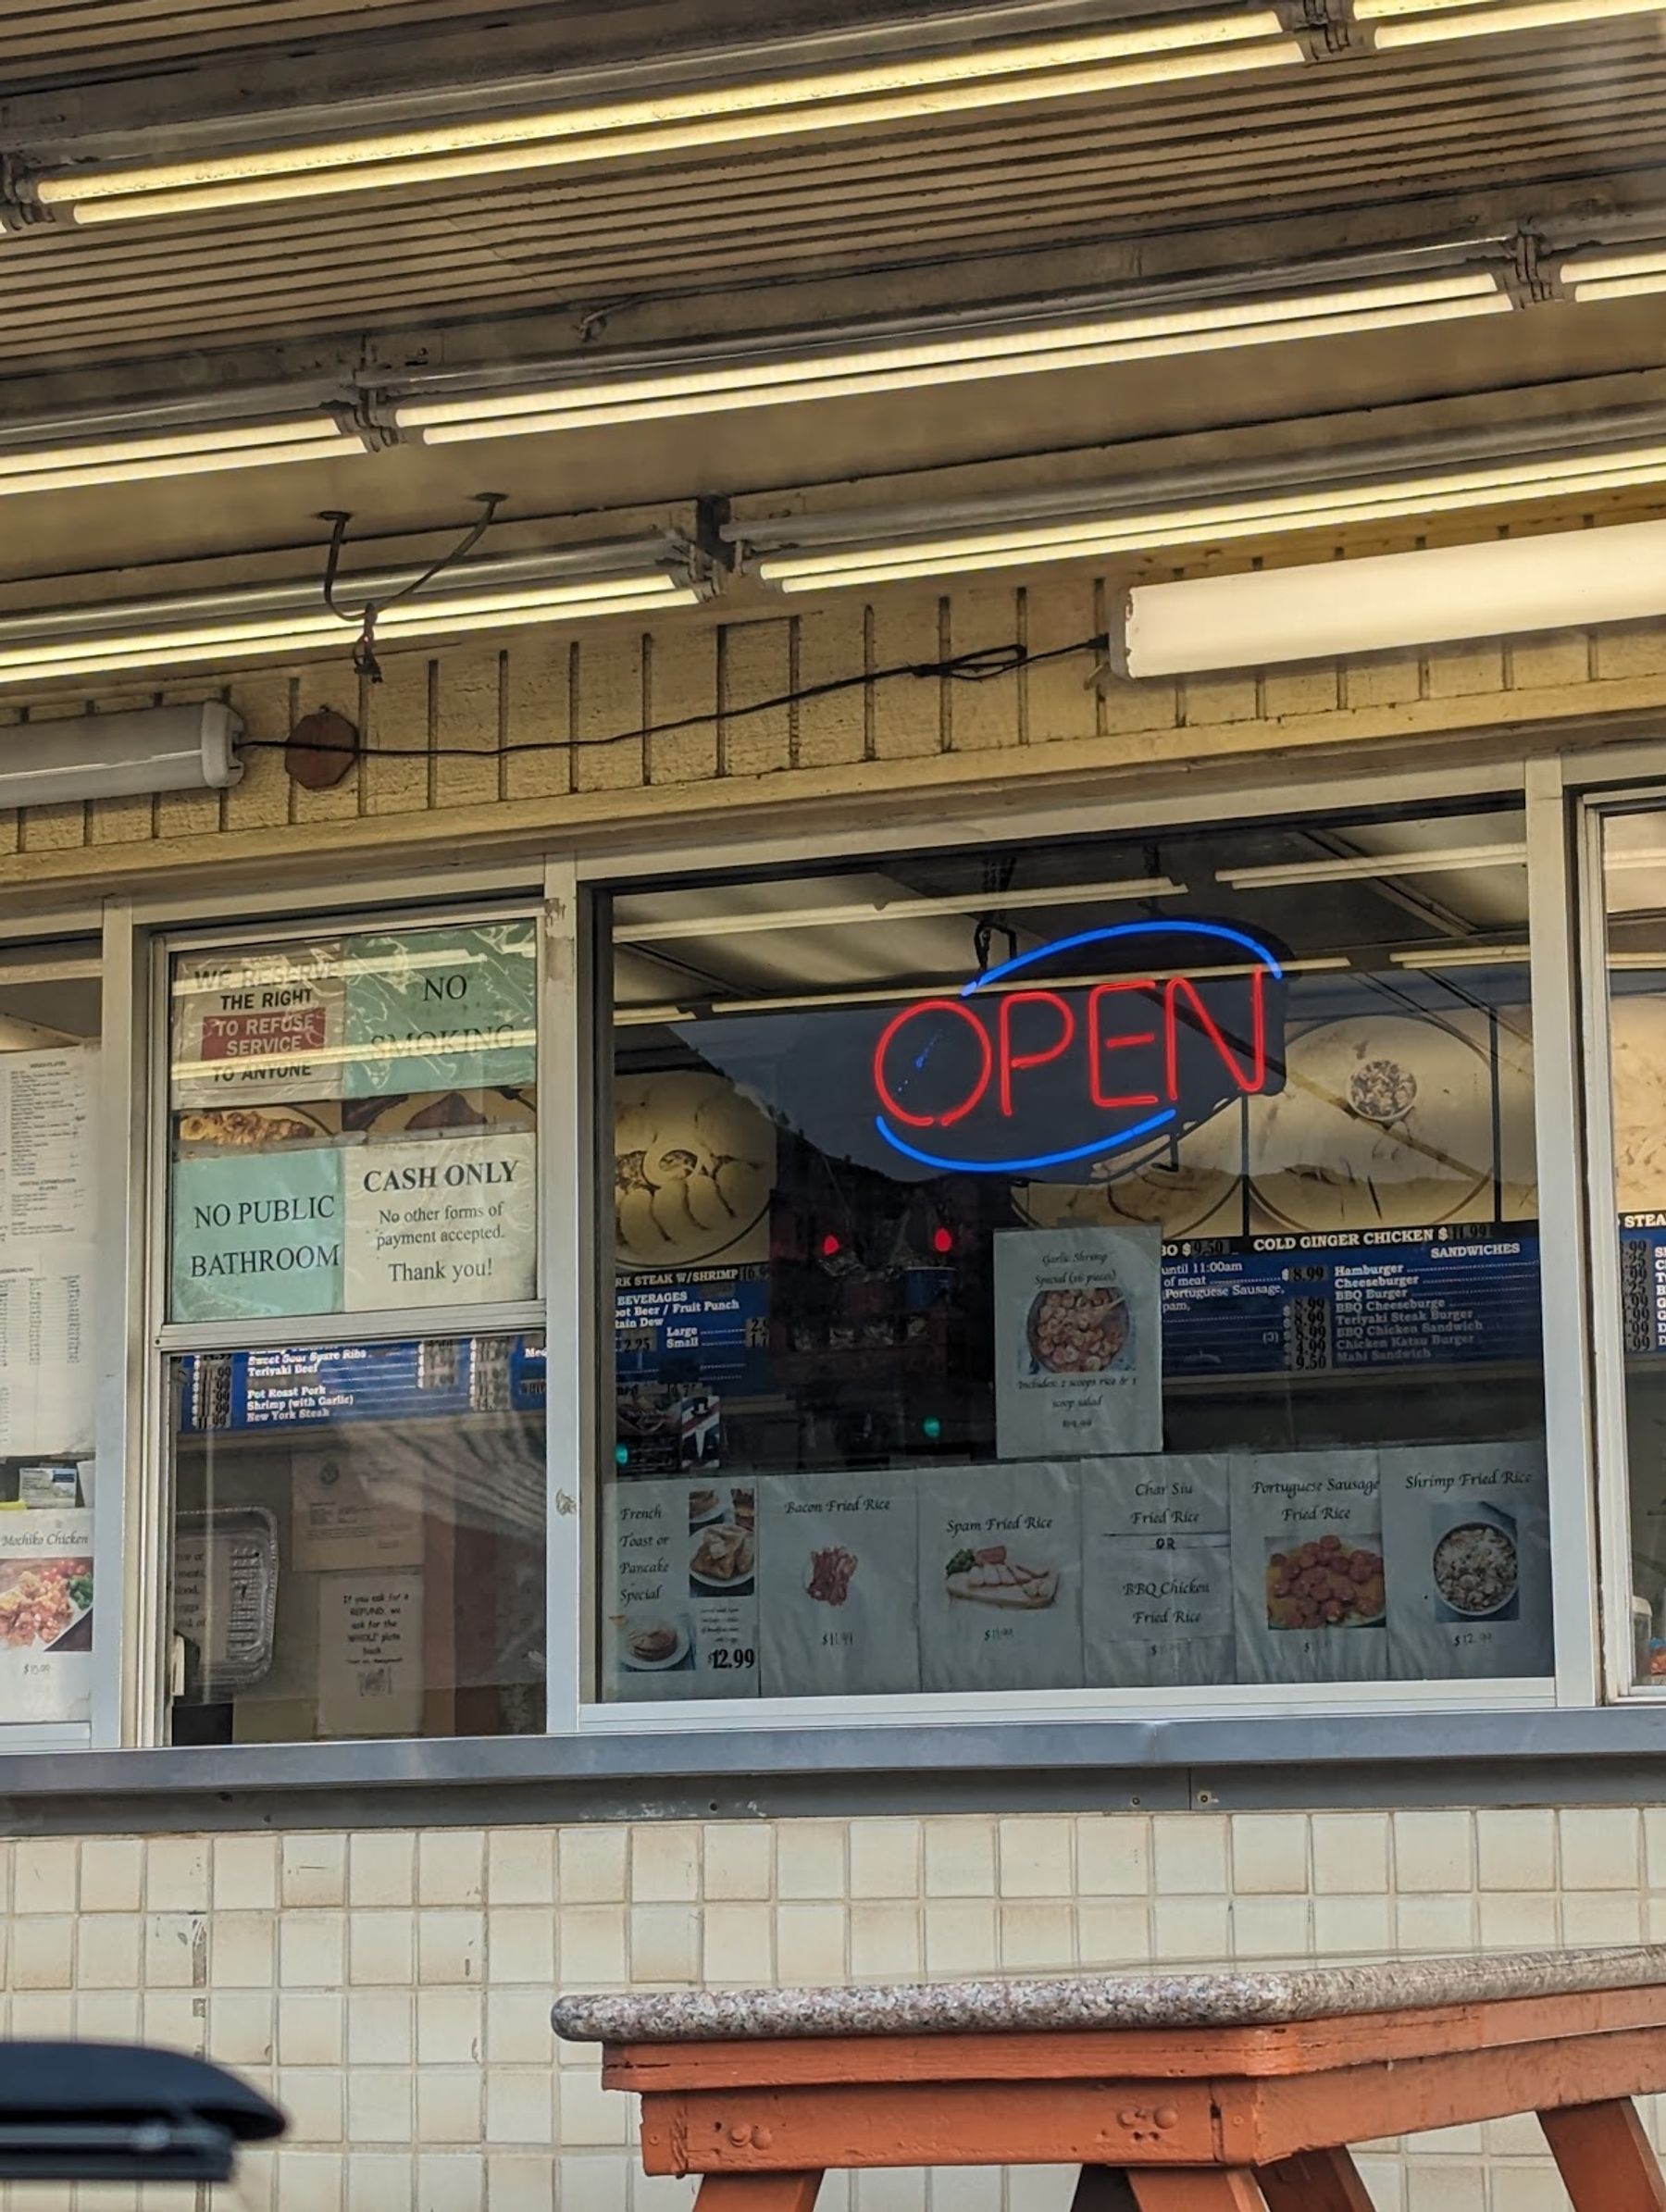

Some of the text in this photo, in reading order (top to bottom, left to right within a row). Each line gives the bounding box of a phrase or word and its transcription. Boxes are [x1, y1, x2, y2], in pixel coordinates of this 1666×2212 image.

[423, 975, 467, 1001] NO
[220, 988, 314, 1011] THE RIGHT
[215, 1014, 315, 1037] TO REFUSE
[226, 1035, 302, 1056] SERVICE
[370, 1025, 517, 1060] SMOKING
[874, 964, 1266, 1128] OPEN
[212, 1066, 235, 1083] TO
[363, 1160, 519, 1194] CASH ONLY
[193, 1195, 336, 1229] NO PUBLIC
[379, 1200, 505, 1225] No other forms of
[375, 1224, 507, 1251] payment accepted.
[1253, 1237, 1296, 1252] COLD
[1299, 1233, 1360, 1249] GINGER
[1362, 1228, 1435, 1246] CHICKEN
[1430, 1242, 1521, 1260] SANDWICHES
[191, 1244, 341, 1279] BATHROOM
[1162, 1261, 1243, 1275] until 11:00am
[388, 1258, 493, 1284] Thank you!
[634, 1273, 674, 1286] STEAK
[675, 1268, 739, 1284] W/SHRIMP
[1334, 1263, 1405, 1278] Hamburger
[1163, 1276, 1176, 1287] of
[1177, 1275, 1207, 1286] meat
[1334, 1274, 1420, 1290] Cheeseburger
[616, 1291, 689, 1307] BEVERAGES
[1334, 1287, 1409, 1302] BBQ Burger
[634, 1305, 661, 1317] Beer
[672, 1302, 702, 1315] Fruit
[703, 1299, 740, 1311] Punch
[1335, 1300, 1363, 1315] BBQ
[640, 1316, 665, 1328] Dew
[1335, 1309, 1474, 1327] Teriyaki Steak Burger
[666, 1326, 699, 1338] Large
[1262, 1331, 1279, 1343] (3)
[1336, 1320, 1484, 1339] BBQ Chicken Sandwich
[666, 1336, 700, 1349] Small
[1336, 1334, 1474, 1350] Chicken Katsu Burger
[342, 1348, 367, 1360] Ribs
[1371, 1348, 1432, 1361] Sandwich
[247, 1362, 319, 1378] Teriyaki Beef
[247, 1386, 327, 1399] Pot Roast Pork
[246, 1395, 354, 1412] Shrimp (with Garlic)
[246, 1408, 331, 1423] New York Steak
[1135, 1481, 1193, 1496] Char Siu
[1252, 1477, 1380, 1499] Portuguese Sausage
[1405, 1471, 1532, 1494] Shrimp Fried Rice
[619, 1504, 662, 1521] French
[785, 1497, 890, 1514] Bacon Fried Rice
[1130, 1510, 1200, 1525] Fried Rice
[1281, 1507, 1351, 1522] Fried Rice
[945, 1515, 1053, 1538] Spam Fried Rice
[1, 1529, 90, 1547] Mochiko Chicken
[619, 1533, 670, 1547] Toast or
[1155, 1537, 1176, 1550] OR
[618, 1559, 669, 1574] Pancake
[1123, 1577, 1211, 1598] BBQ Chicken
[619, 1586, 661, 1607] Special
[1132, 1609, 1201, 1625] Fried Rice
